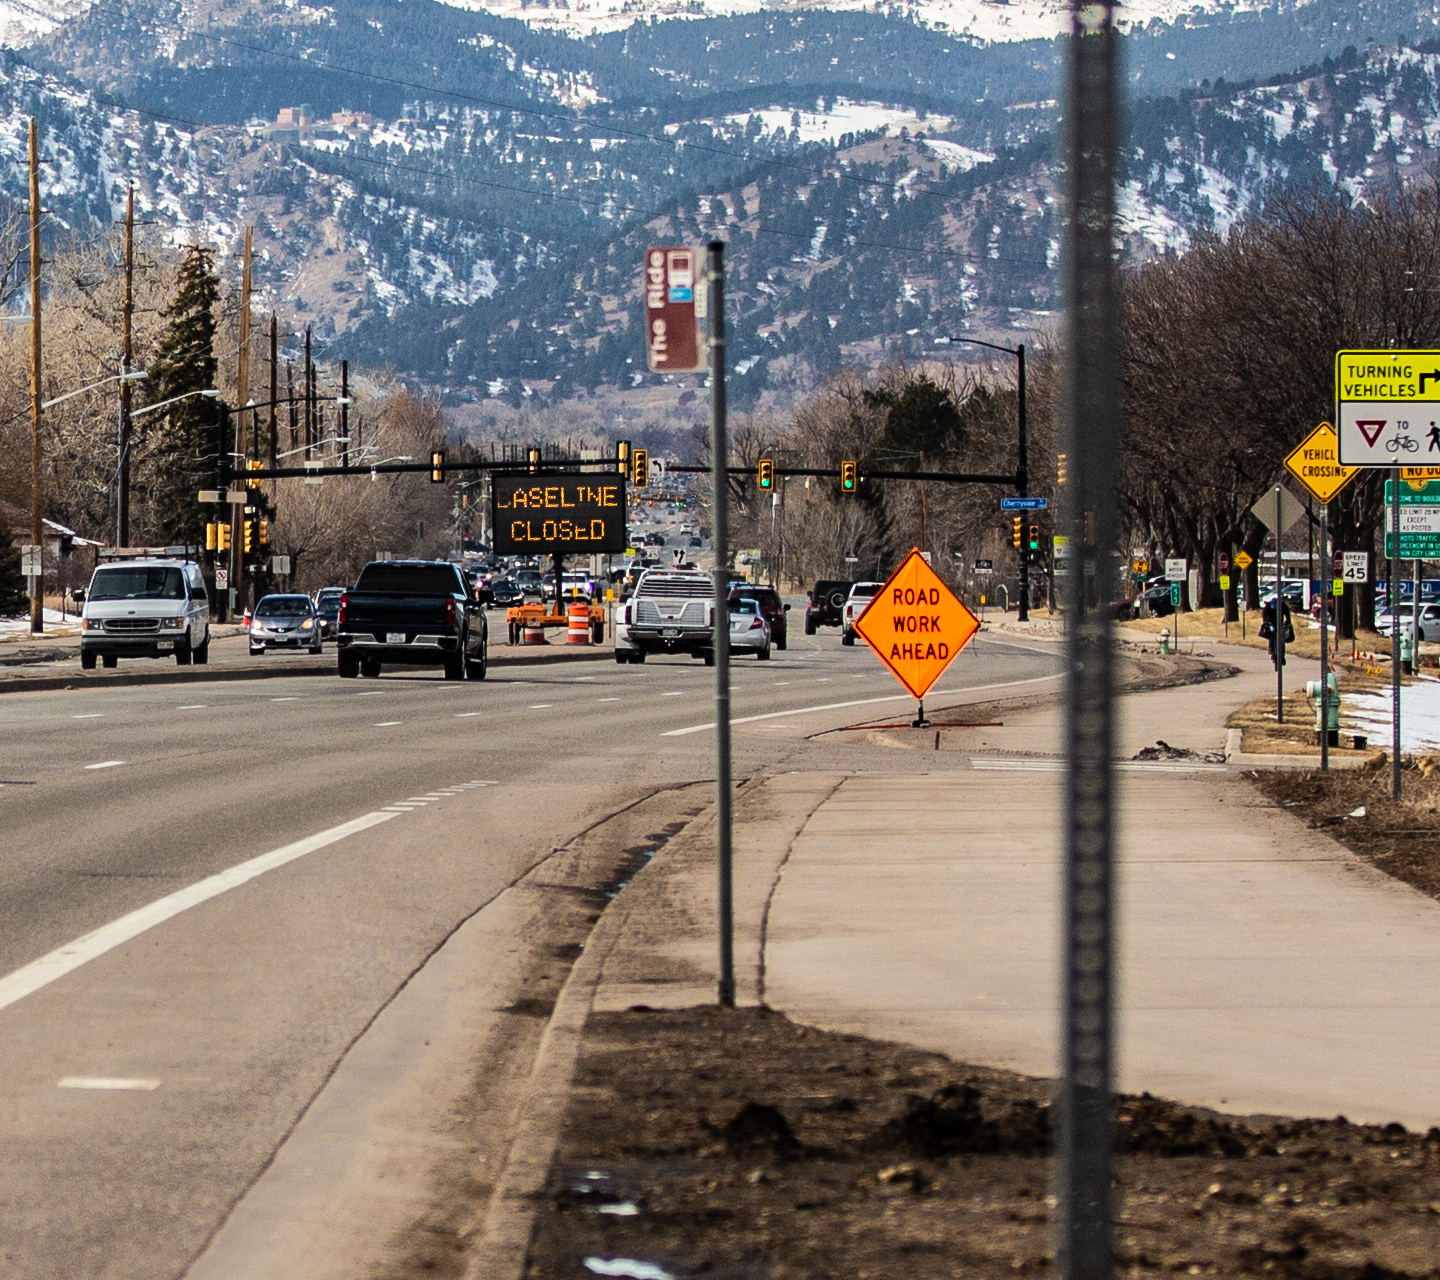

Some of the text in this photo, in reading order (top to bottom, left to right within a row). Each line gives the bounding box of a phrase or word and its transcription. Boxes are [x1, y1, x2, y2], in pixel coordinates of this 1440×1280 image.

[647, 251, 668, 368] The Ride
[1348, 366, 1412, 378] TURNING
[1344, 384, 1416, 397] VEHICLES
[1397, 421, 1409, 430] TO
[1303, 449, 1335, 460] VEHICL
[1302, 466, 1347, 477] CROSSING
[511, 519, 605, 540] CLOSED
[1345, 567, 1366, 580] 45
[893, 588, 940, 605] ROAD
[893, 615, 941, 633] WORK
[890, 642, 949, 659] AHEAD
